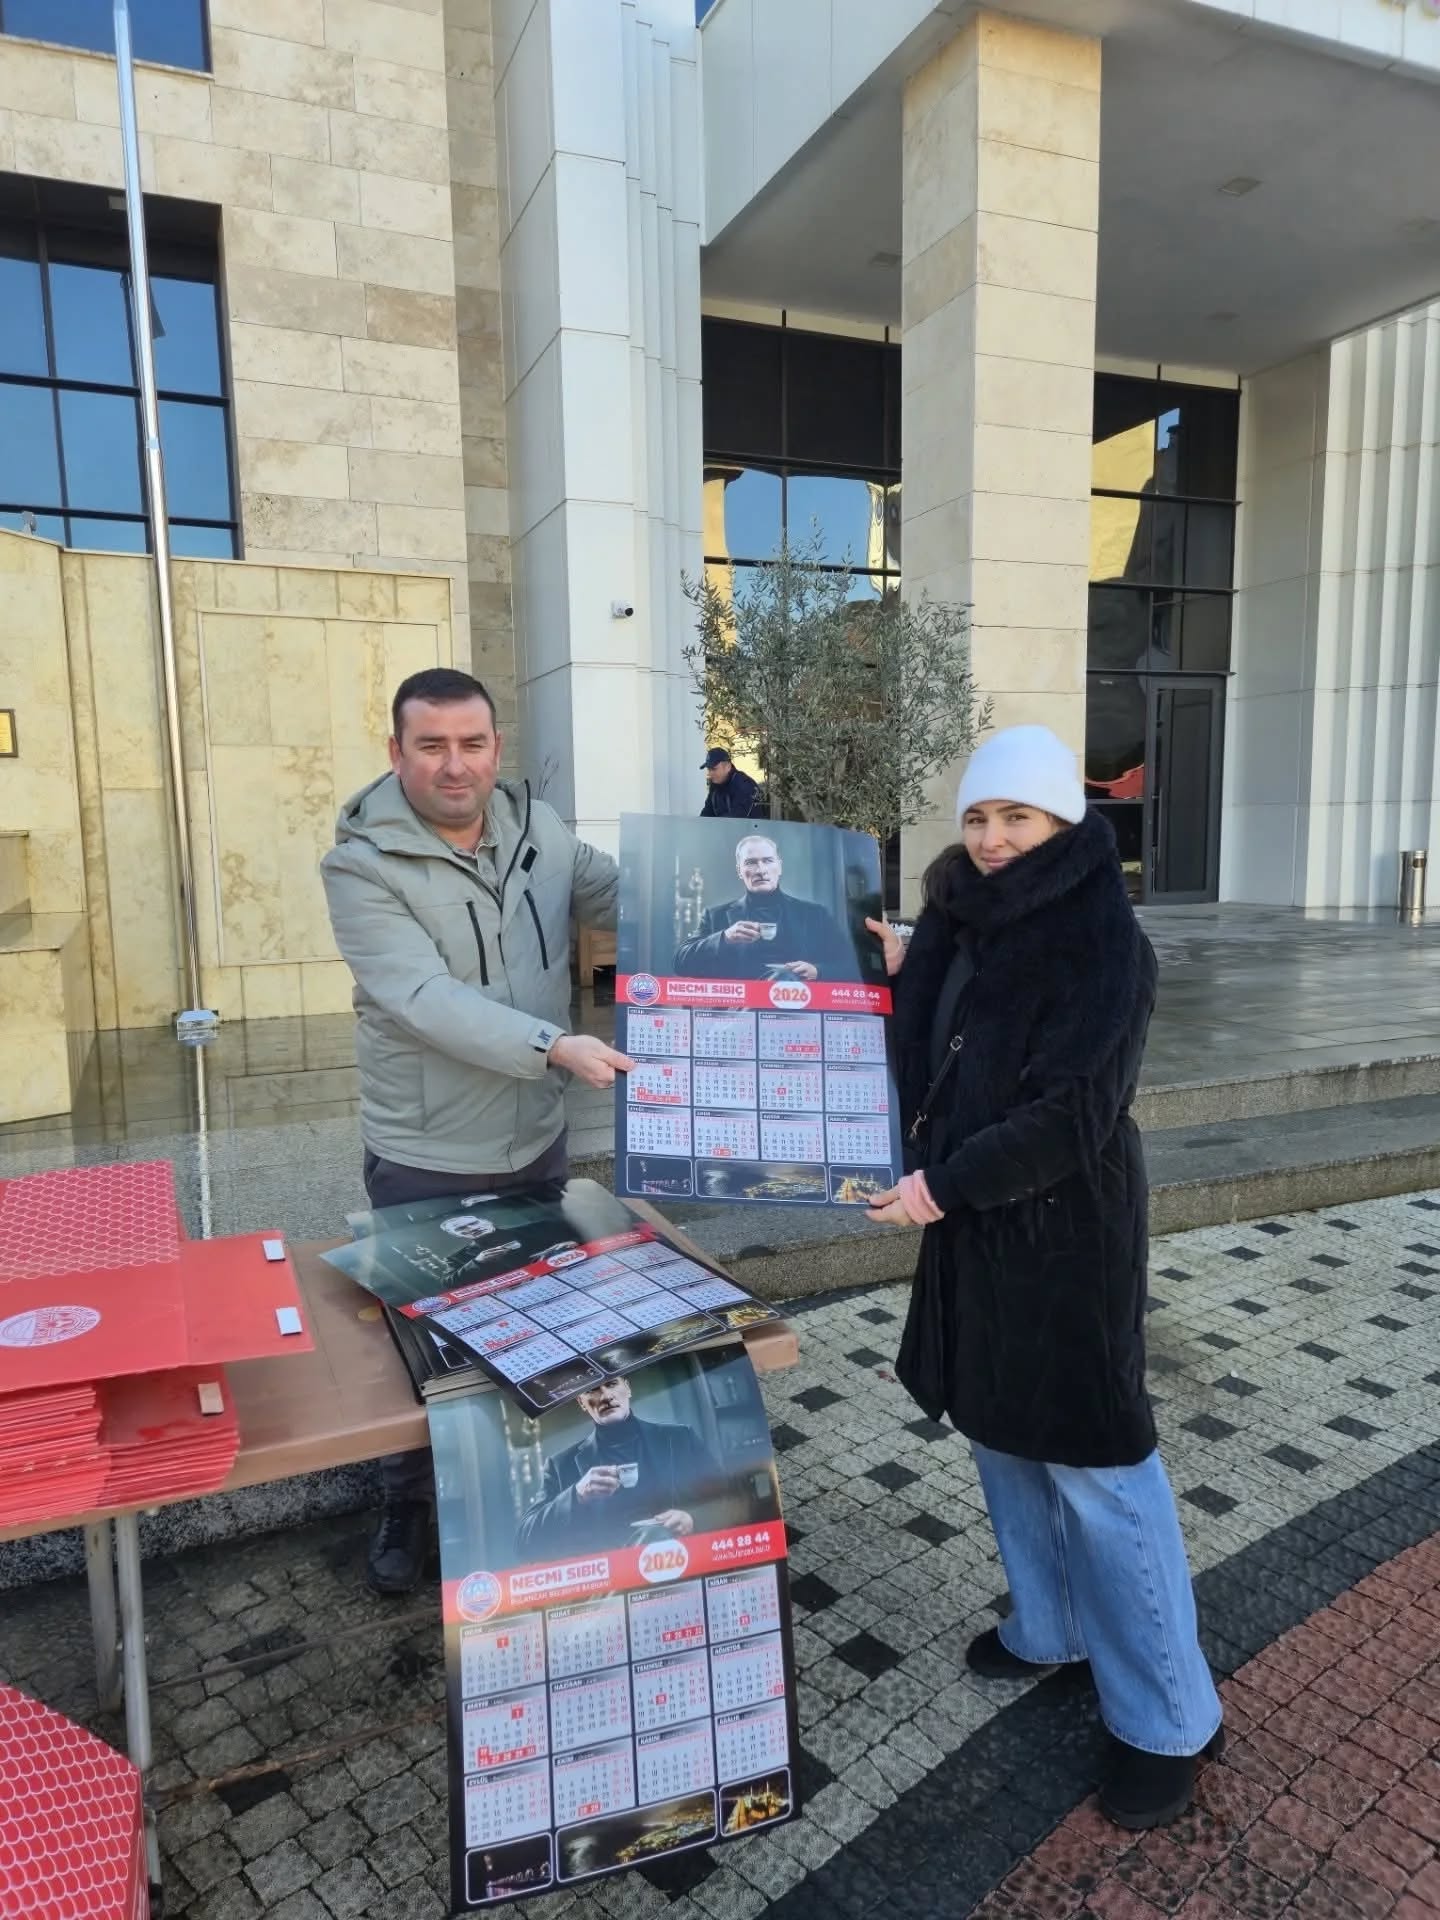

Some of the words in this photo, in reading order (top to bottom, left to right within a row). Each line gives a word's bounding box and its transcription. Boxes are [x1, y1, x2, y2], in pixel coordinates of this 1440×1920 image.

[668, 983, 708, 994] NECMİ
[773, 987, 809, 1002] 2026
[831, 989, 850, 997] 444
[868, 991, 880, 999] 44
[711, 1538, 733, 1551] 444
[737, 1535, 751, 1547] 28
[755, 1532, 770, 1543] 44
[643, 1549, 685, 1572] 2026
[512, 1569, 562, 1590] NECMİ
[566, 1561, 606, 1580] SIBIÇ
